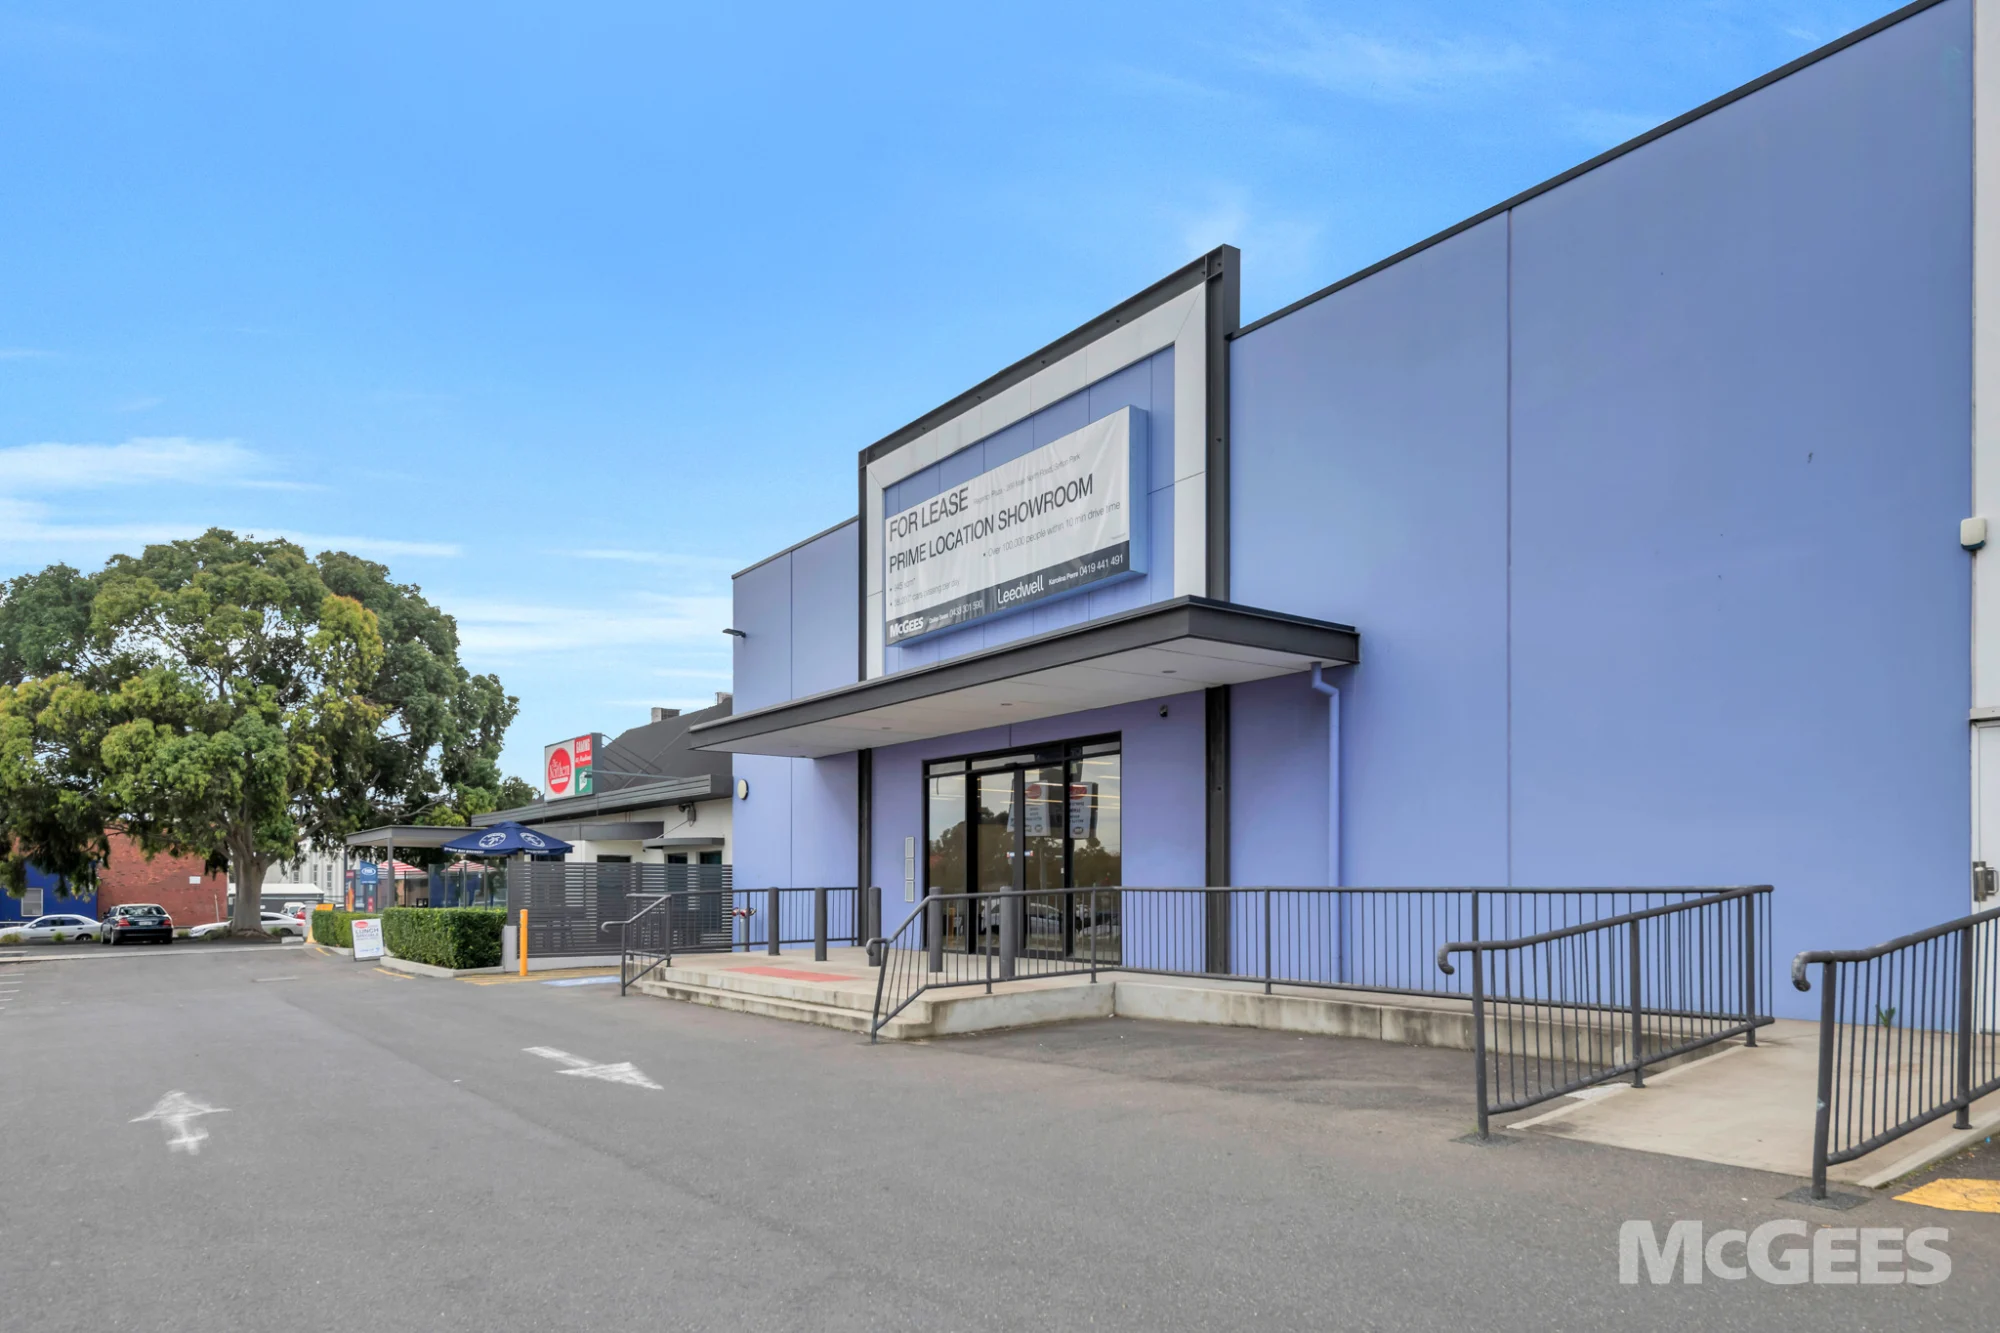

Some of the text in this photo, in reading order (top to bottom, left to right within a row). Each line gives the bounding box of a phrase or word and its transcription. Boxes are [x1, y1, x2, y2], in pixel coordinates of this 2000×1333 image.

[889, 486, 969, 542] FOR LEASE
[889, 473, 1093, 574] PRIME LOCATION SHOWROOM
[987, 546, 1001, 558] Over
[1025, 528, 1047, 545] people
[1047, 522, 1065, 536] within
[1066, 517, 1074, 528] 10
[1074, 513, 1087, 525] min
[1087, 507, 1104, 520] drive
[1106, 501, 1121, 514] time
[1079, 562, 1096, 577] 0419
[1096, 558, 1109, 570] 441
[1110, 553, 1123, 566] 491
[997, 574, 1044, 604] Leedwell
[889, 617, 924, 638] McGEES
[355, 927, 379, 935] LUNCH
